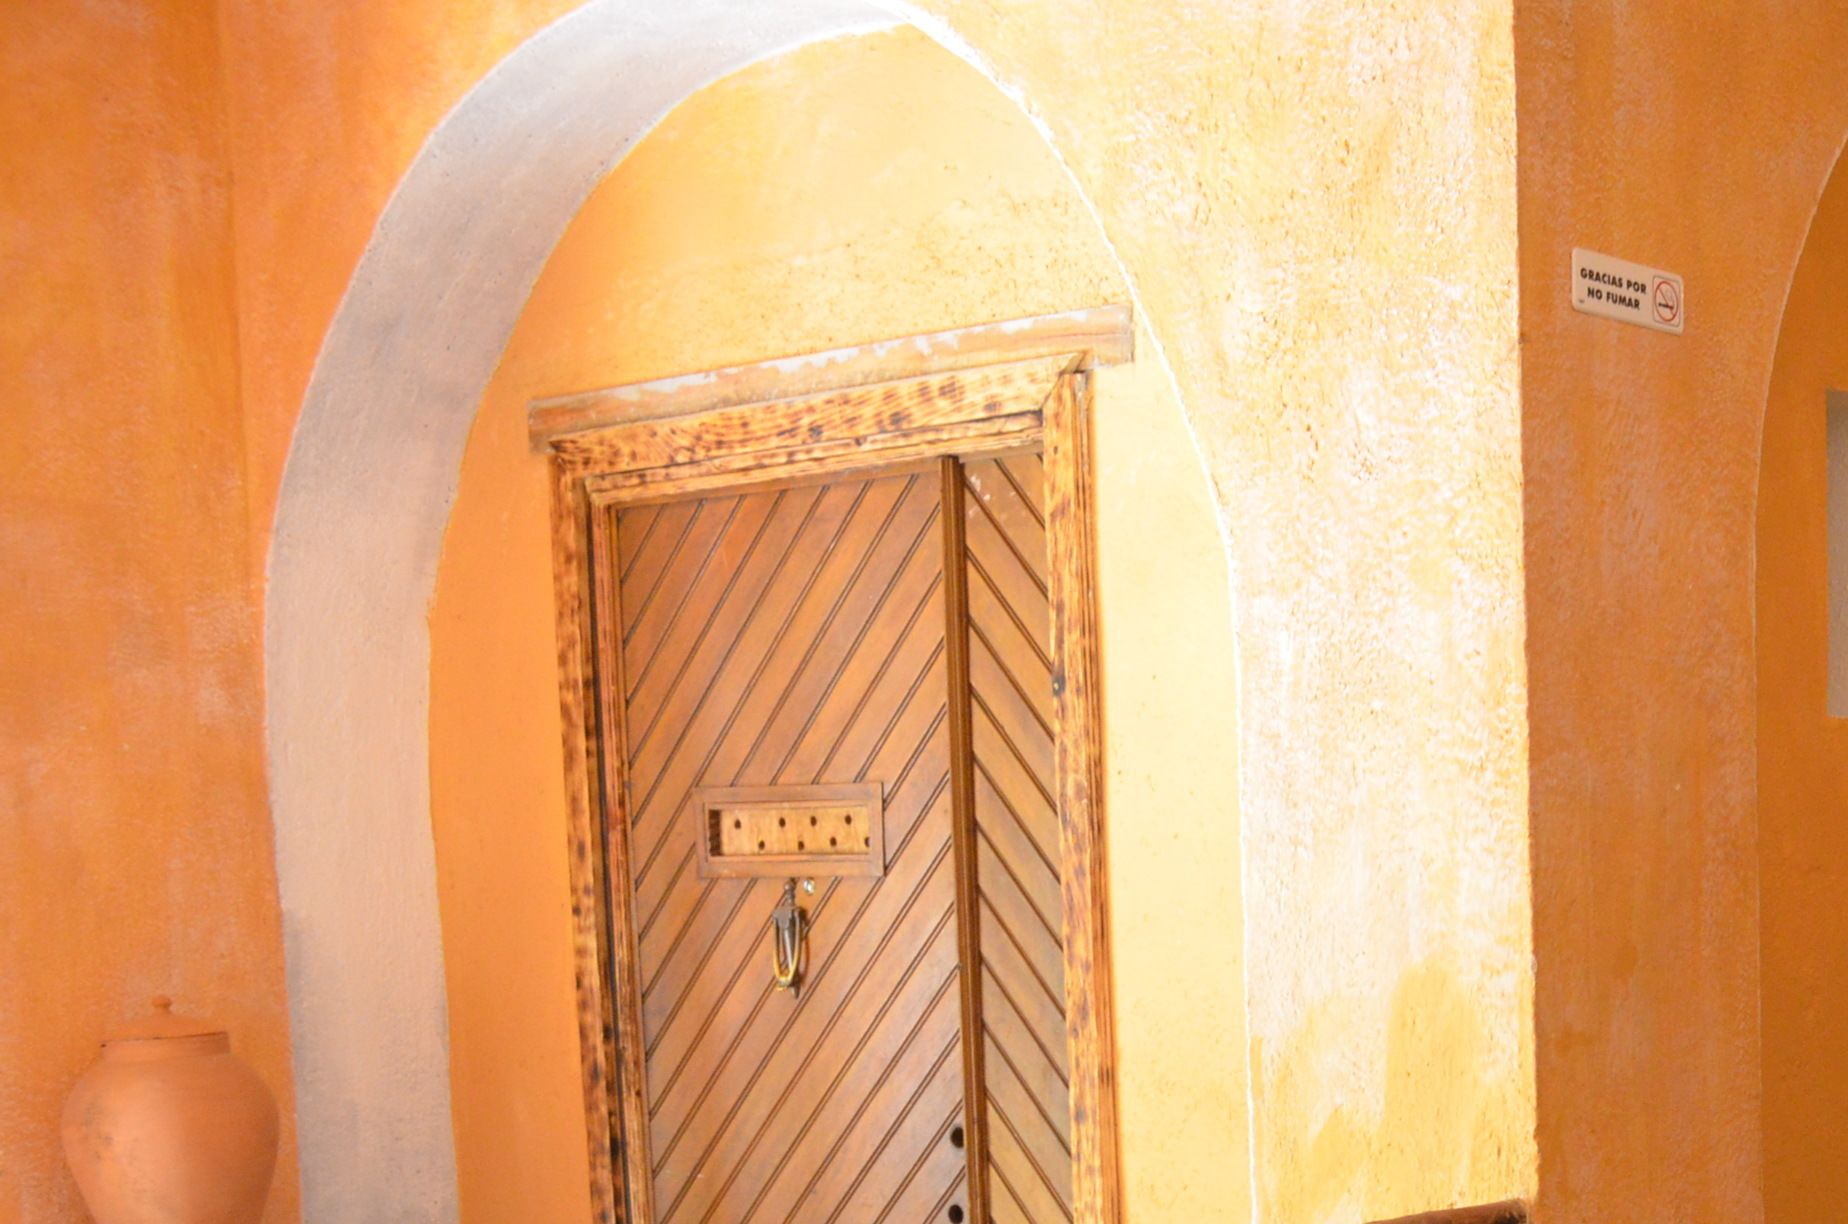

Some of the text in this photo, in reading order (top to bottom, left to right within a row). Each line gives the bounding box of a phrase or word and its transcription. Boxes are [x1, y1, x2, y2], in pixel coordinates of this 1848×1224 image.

[1580, 268, 1647, 294] GRACIAS POR
[1587, 287, 1640, 310] NO FUMAR
